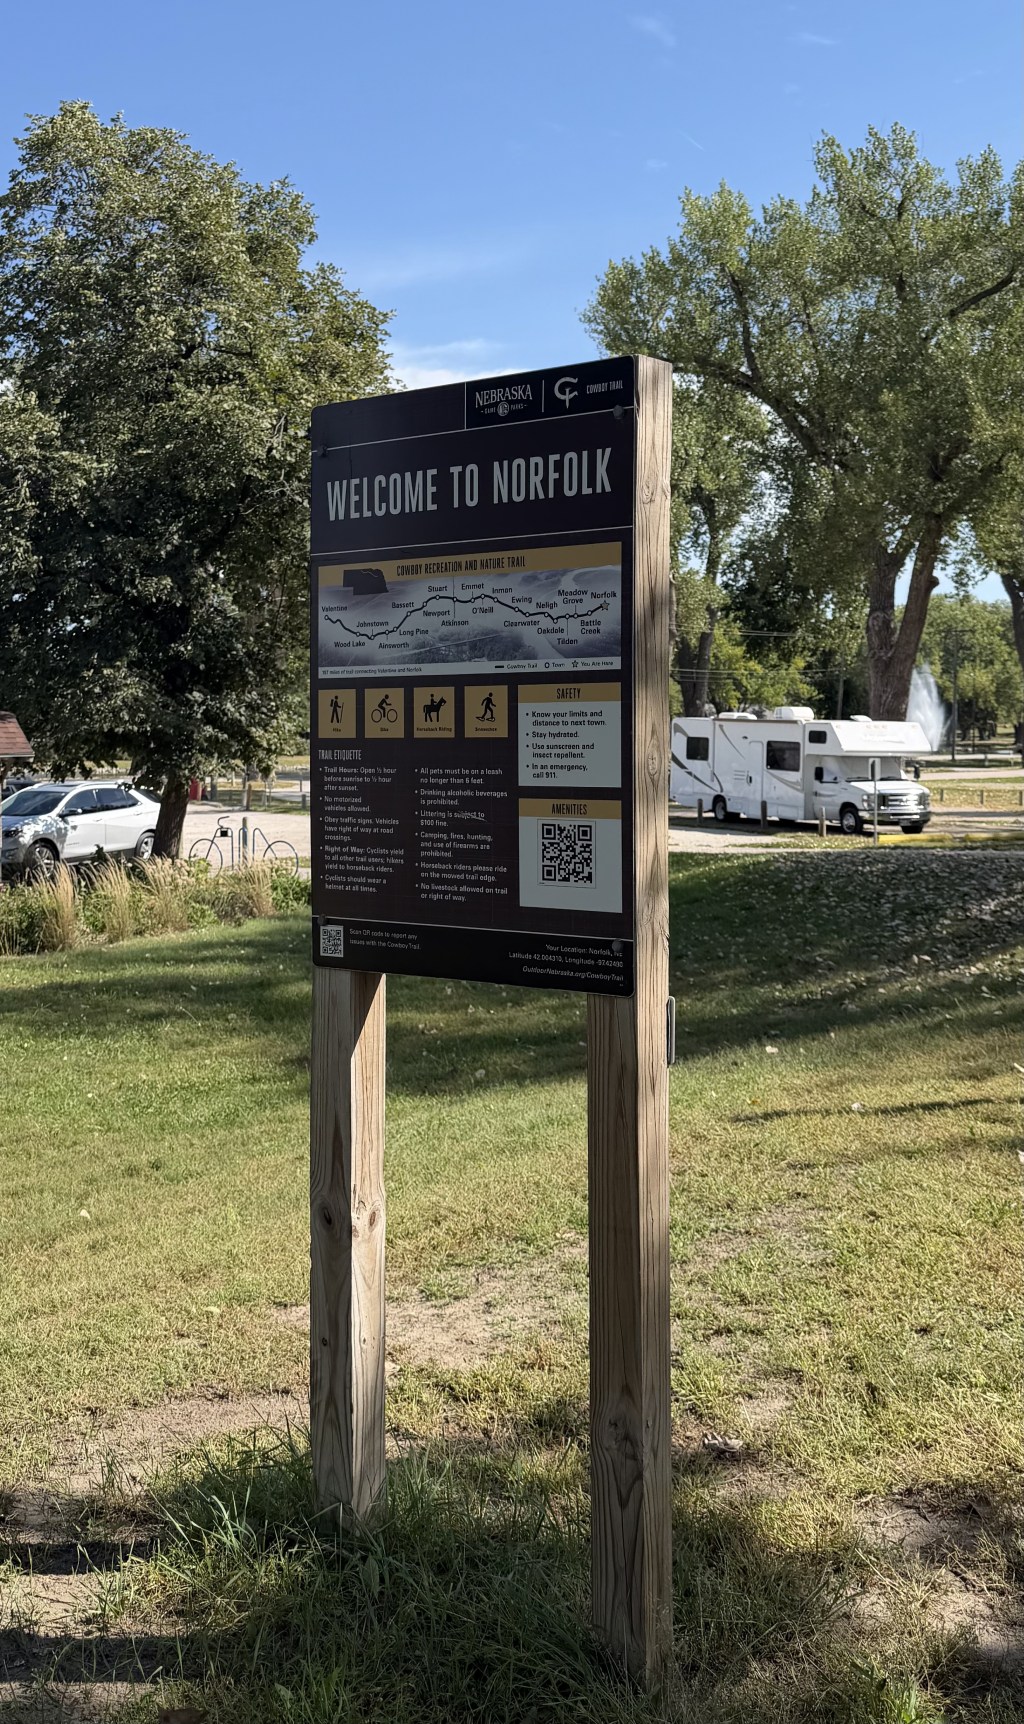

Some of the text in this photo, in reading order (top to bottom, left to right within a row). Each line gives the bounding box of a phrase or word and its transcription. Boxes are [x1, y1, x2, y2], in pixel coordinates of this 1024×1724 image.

[587, 380, 623, 394] COWBOY TRAIL
[476, 384, 532, 408] NEBRASKA
[327, 448, 611, 521] WELCOME TO NORFOLK
[397, 556, 525, 576] COWBOY RECREATION AND NATURE TRAIL
[557, 688, 581, 699] SAFETY
[334, 750, 362, 760] ETIQUETTE
[552, 804, 587, 815] AMENITIES
[420, 832, 448, 840] Camping,
[467, 833, 493, 841] hunting,
